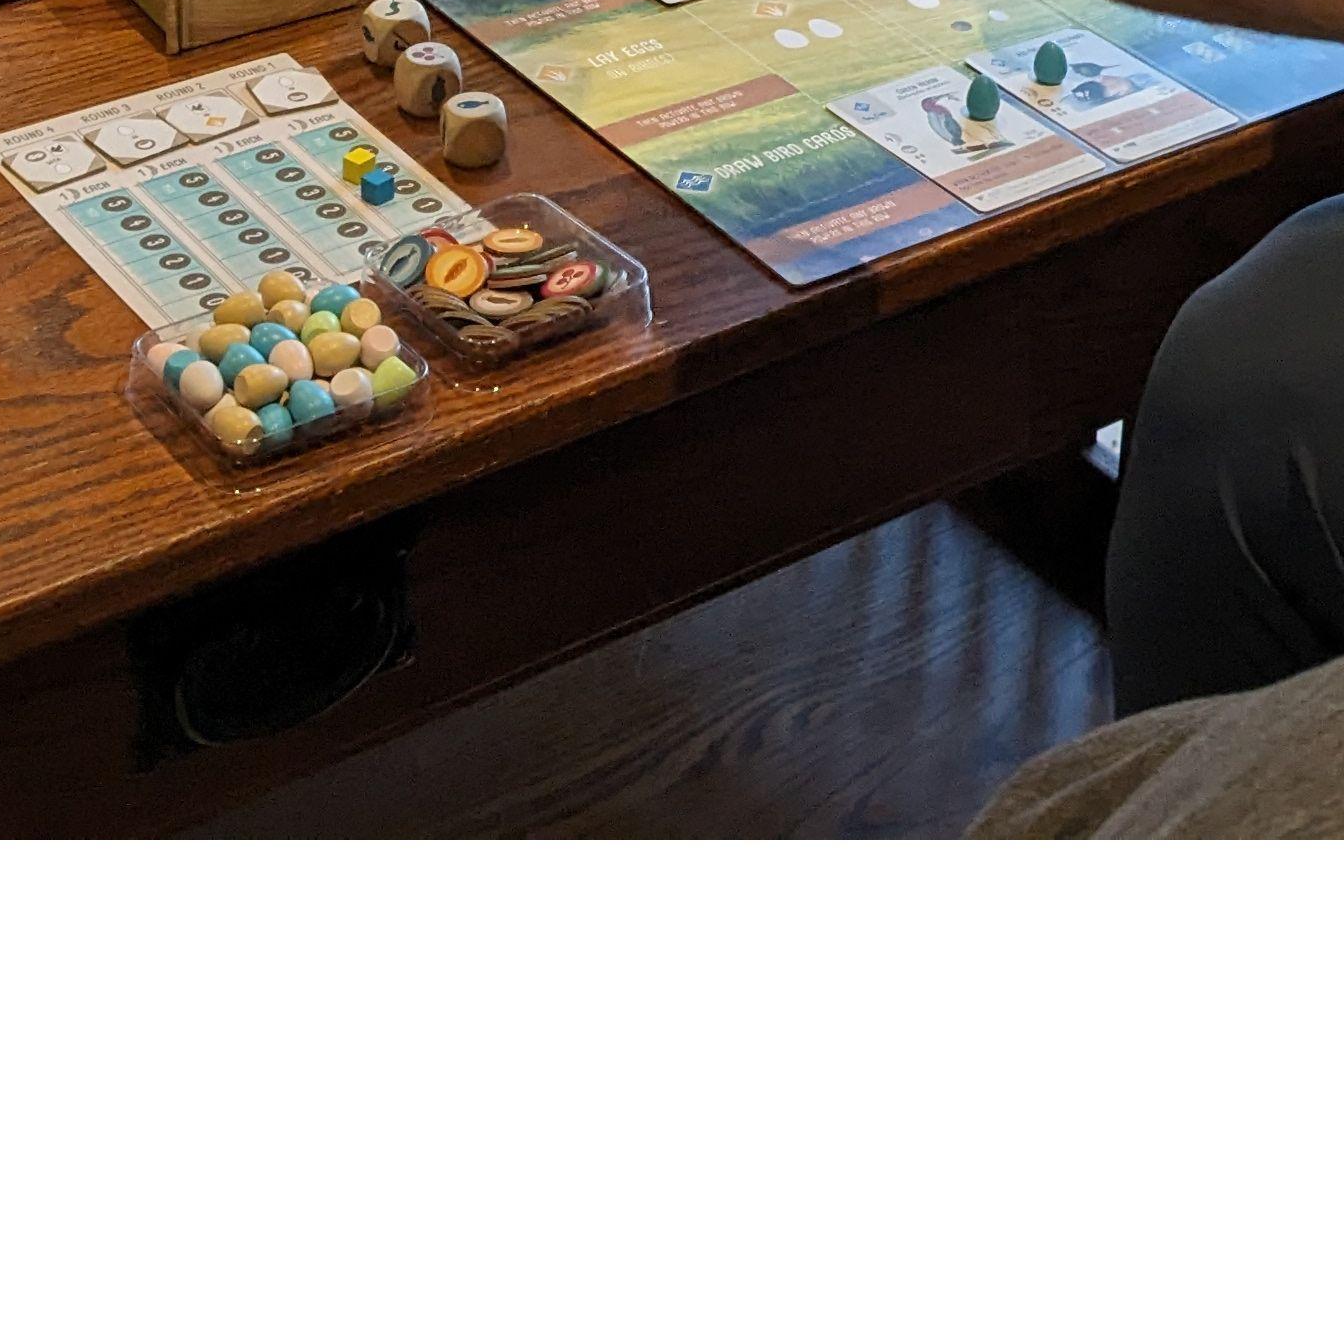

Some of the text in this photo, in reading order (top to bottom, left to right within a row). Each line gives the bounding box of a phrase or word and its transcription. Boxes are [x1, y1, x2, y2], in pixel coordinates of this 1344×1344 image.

[588, 38, 664, 68] LAY EGGS
[228, 62, 276, 81] ROUND 1
[156, 82, 206, 102] ROUND 2
[80, 103, 132, 123] ROUND 3
[308, 113, 336, 126] EACH
[3, 130, 43, 146] ROUND
[235, 134, 263, 149] EACH
[713, 125, 857, 180] DRAW BIRD CARDS
[159, 157, 188, 172] EACH
[82, 181, 111, 194] EACH
